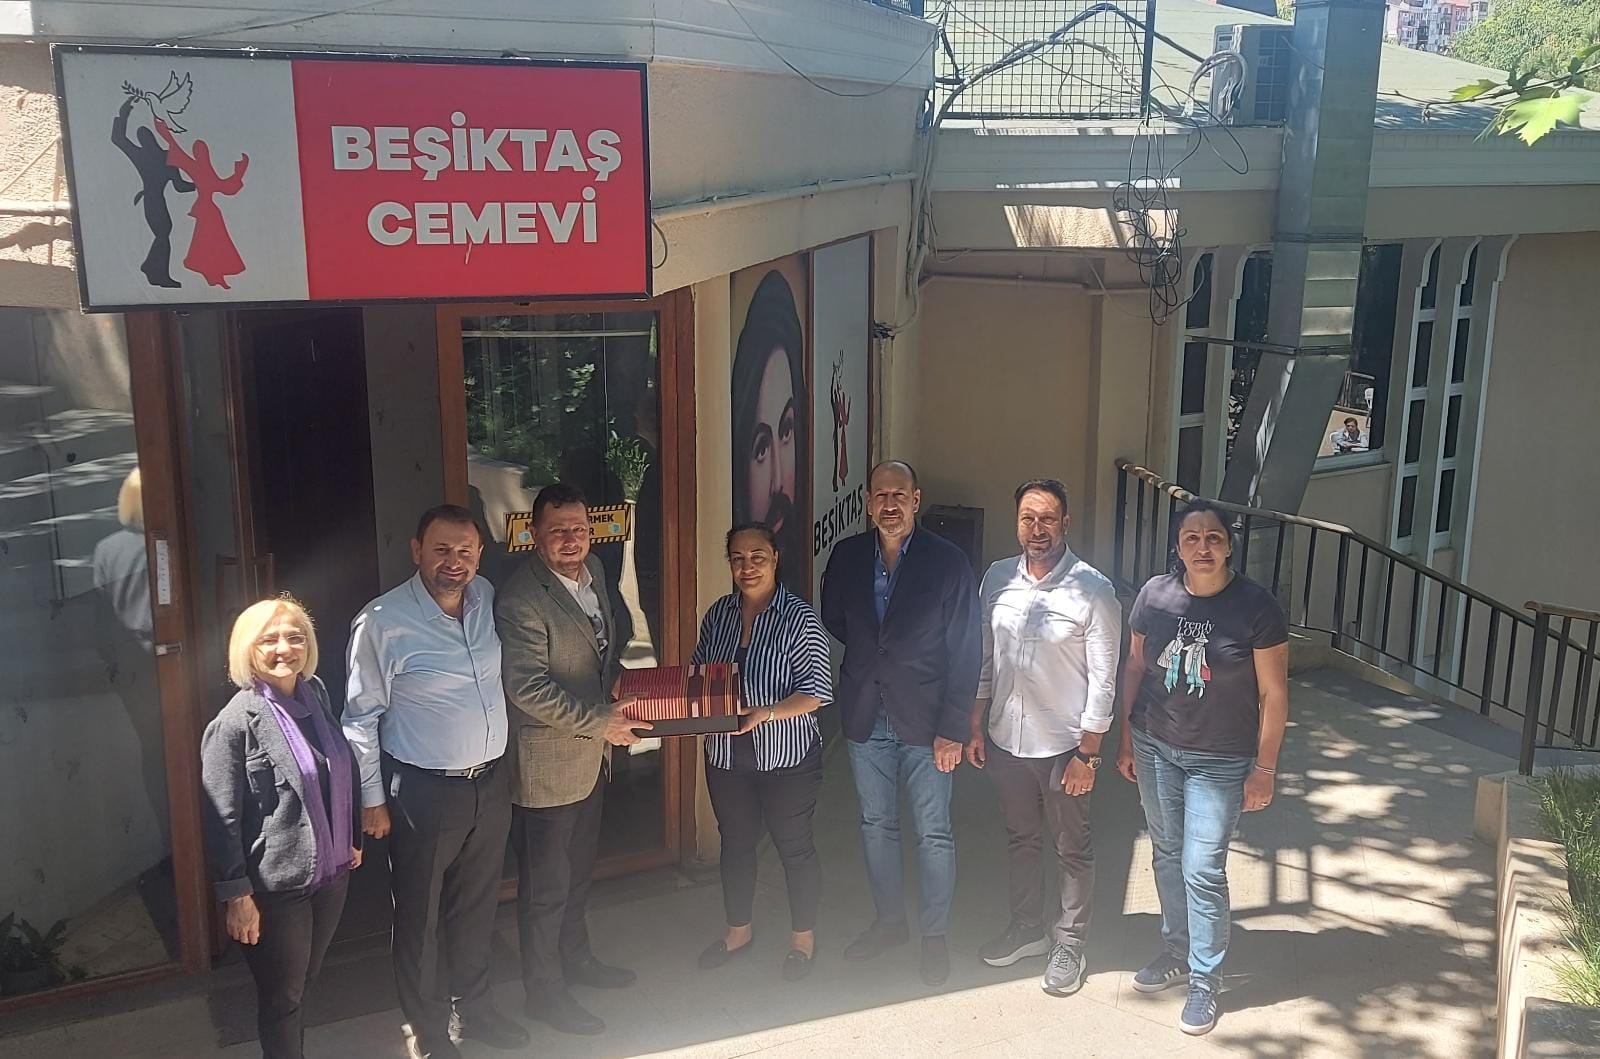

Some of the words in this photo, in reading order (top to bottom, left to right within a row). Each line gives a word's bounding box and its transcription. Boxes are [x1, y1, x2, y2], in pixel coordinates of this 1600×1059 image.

[331, 111, 622, 182] BEŞİKTAŞ
[367, 186, 598, 246] CEMEVİ
[588, 513, 615, 525] RMEK
[814, 483, 863, 557] BEŞİKTAŞ
[1176, 626, 1207, 640] Look
[1177, 616, 1215, 635] Trendy
